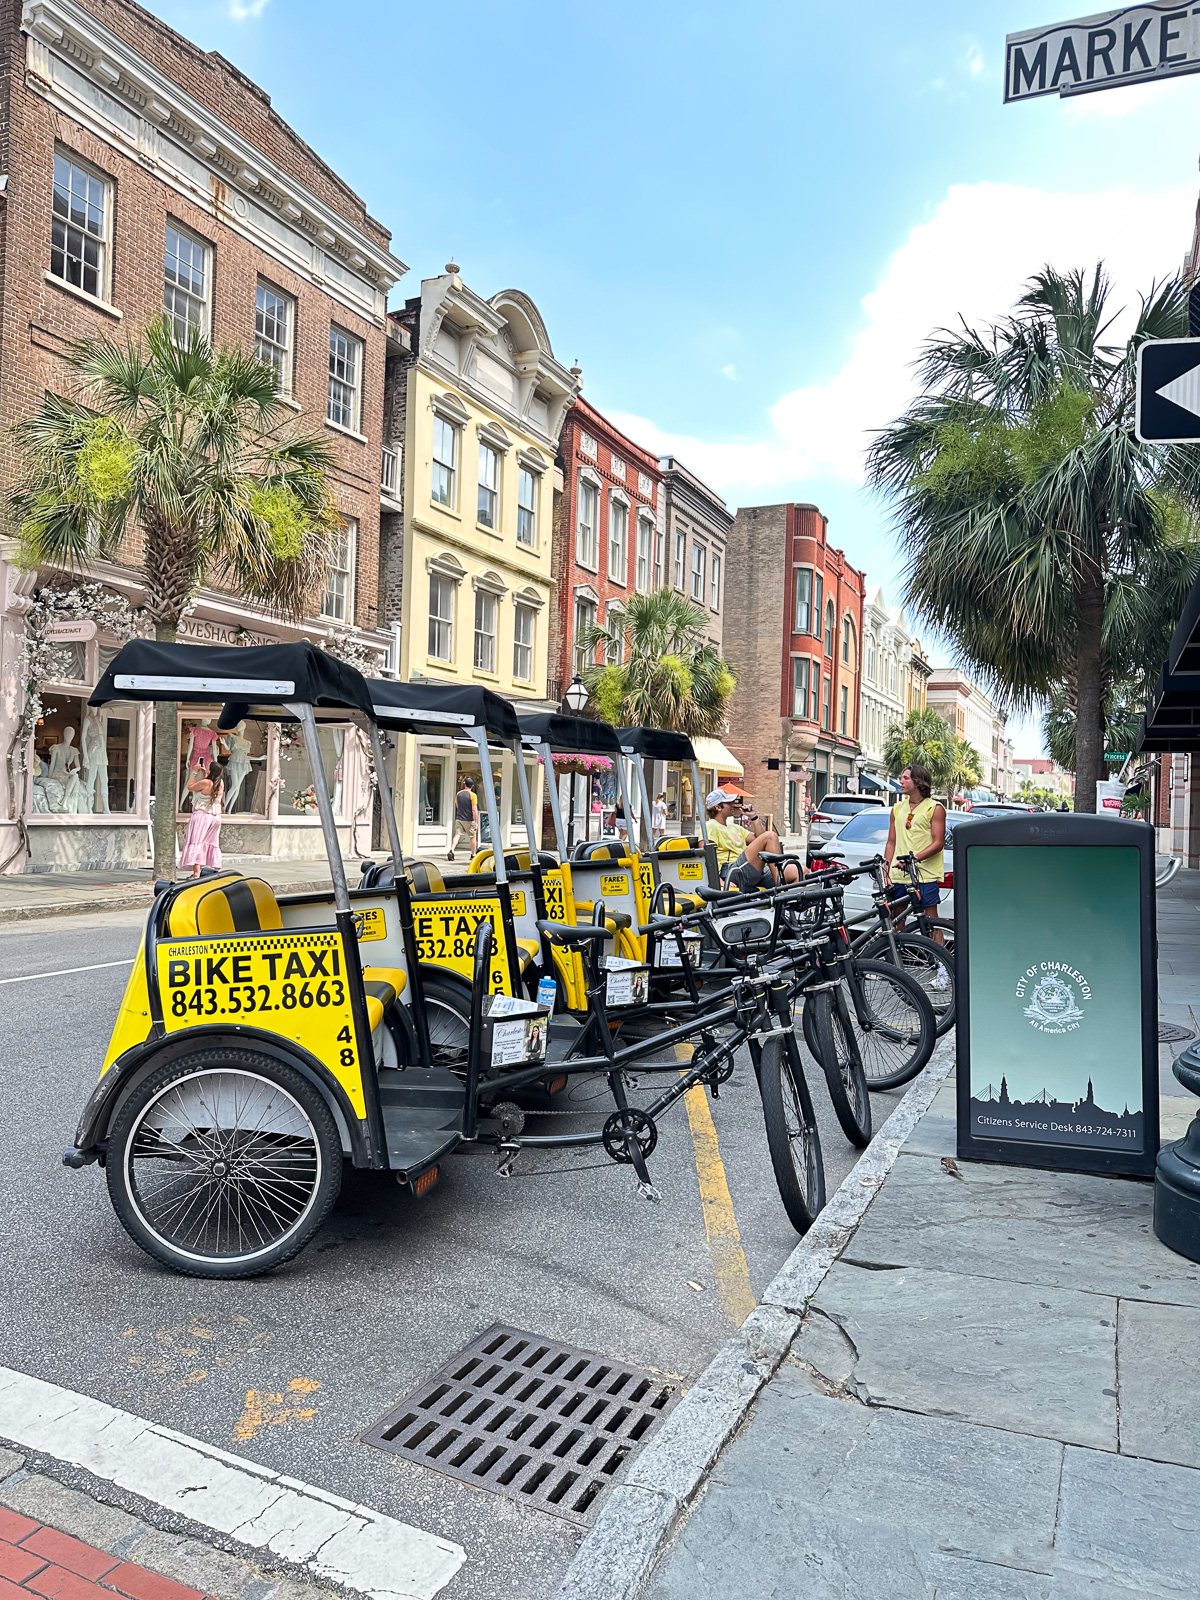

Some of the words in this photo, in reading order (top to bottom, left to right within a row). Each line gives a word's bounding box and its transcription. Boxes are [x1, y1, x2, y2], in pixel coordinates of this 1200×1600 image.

[1012, 9, 1200, 96] MARKE
[1104, 752, 1125, 760] Princess
[168, 944, 209, 957] CHARLESTON
[168, 954, 254, 988] BIKE
[262, 949, 341, 981] TAXI
[1015, 975, 1029, 998] CITY
[1026, 964, 1040, 977] OF
[1040, 961, 1093, 1001] CHARLESTON
[171, 980, 345, 1017] 843.532.8663
[1029, 1019, 1039, 1028] All
[1038, 1024, 1067, 1034] America
[1066, 1021, 1081, 1032] City
[977, 1115, 1013, 1127] Citizens
[1015, 1119, 1048, 1131] Service
[1050, 1122, 1074, 1133] Desk
[1075, 1125, 1137, 1138] 843-724-7311
